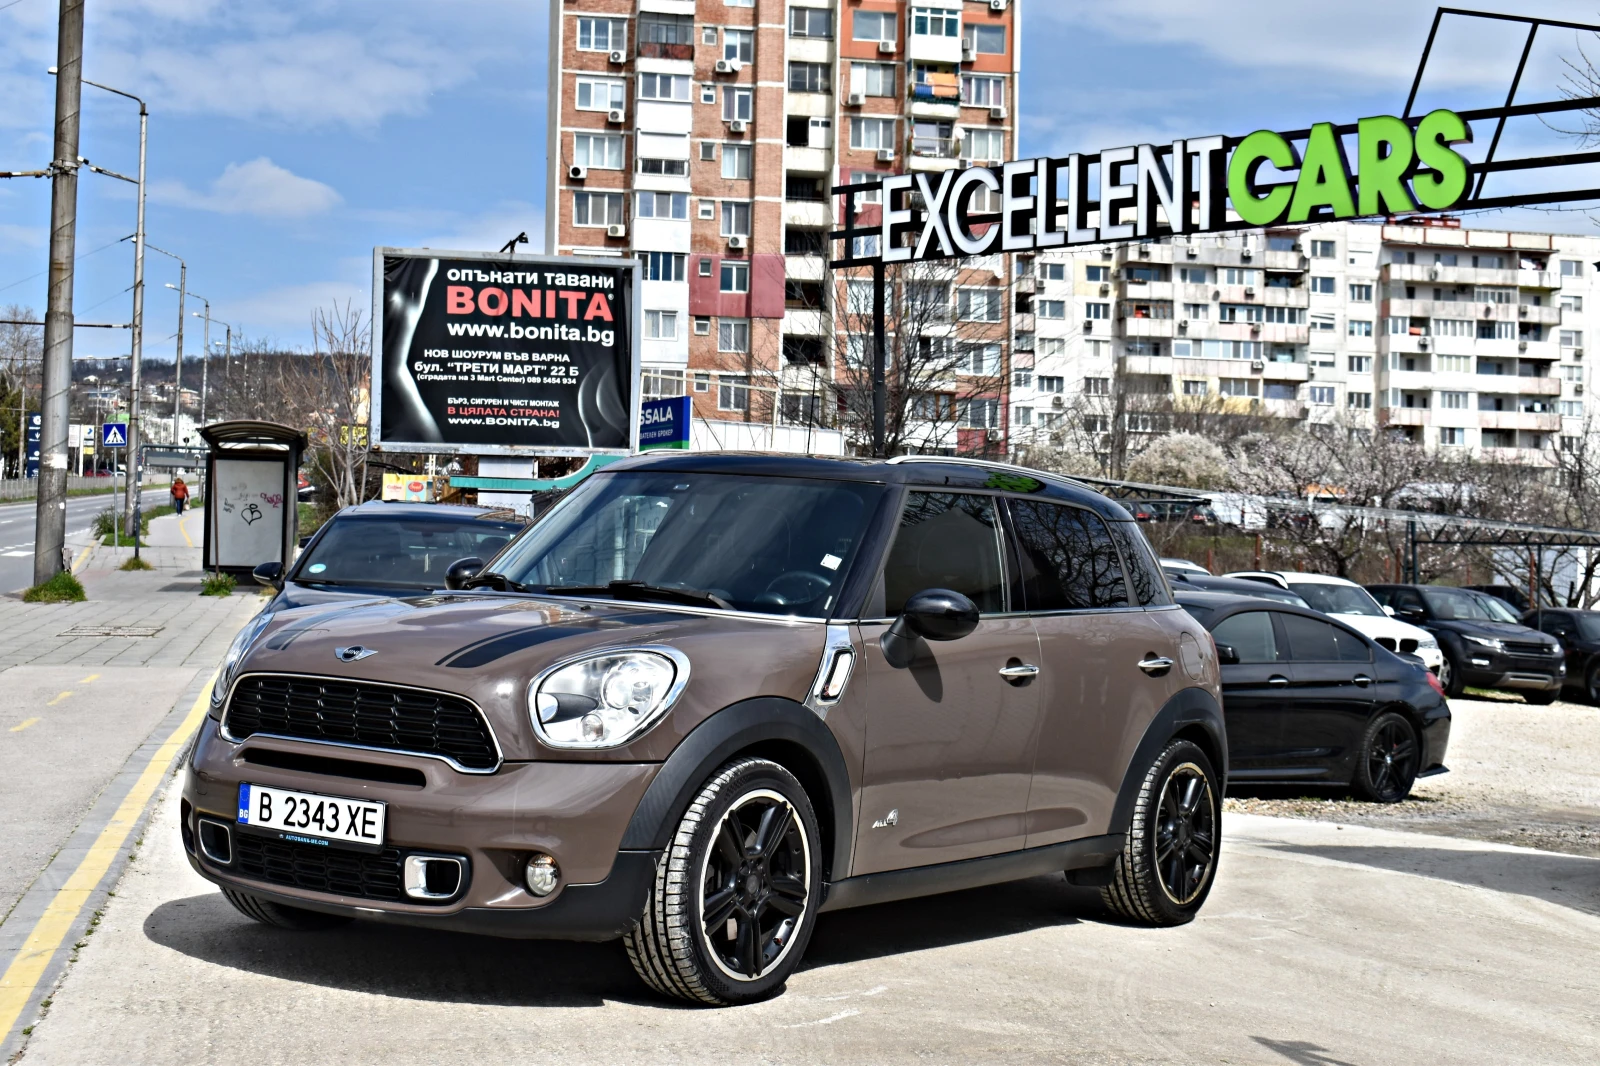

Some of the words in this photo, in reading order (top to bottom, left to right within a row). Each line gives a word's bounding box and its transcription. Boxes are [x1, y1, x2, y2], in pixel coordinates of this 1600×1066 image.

[881, 134, 1226, 262] EXCELLENT
[1228, 109, 1473, 226] CARS
[447, 269, 538, 284] опънати
[544, 272, 614, 288] тавани
[447, 285, 613, 321] BONITA
[447, 322, 614, 346] www.bonita.bg
[424, 349, 449, 358] НОВ
[452, 350, 501, 360] ШОУРУМ
[504, 352, 529, 361] ВЪВ
[532, 353, 570, 362] ВАРНА
[414, 361, 443, 373] бул.
[550, 366, 566, 376] 22
[470, 398, 502, 406] СИГУРЕН
[503, 398, 509, 406] И
[459, 407, 507, 416] ЦЯЛАТА
[510, 408, 560, 417] СТРАНА!
[447, 417, 560, 428] www.BONITA.bg
[239, 809, 248, 819] BG
[259, 792, 272, 822] B
[283, 796, 340, 833] 2343
[345, 804, 378, 839] XE
